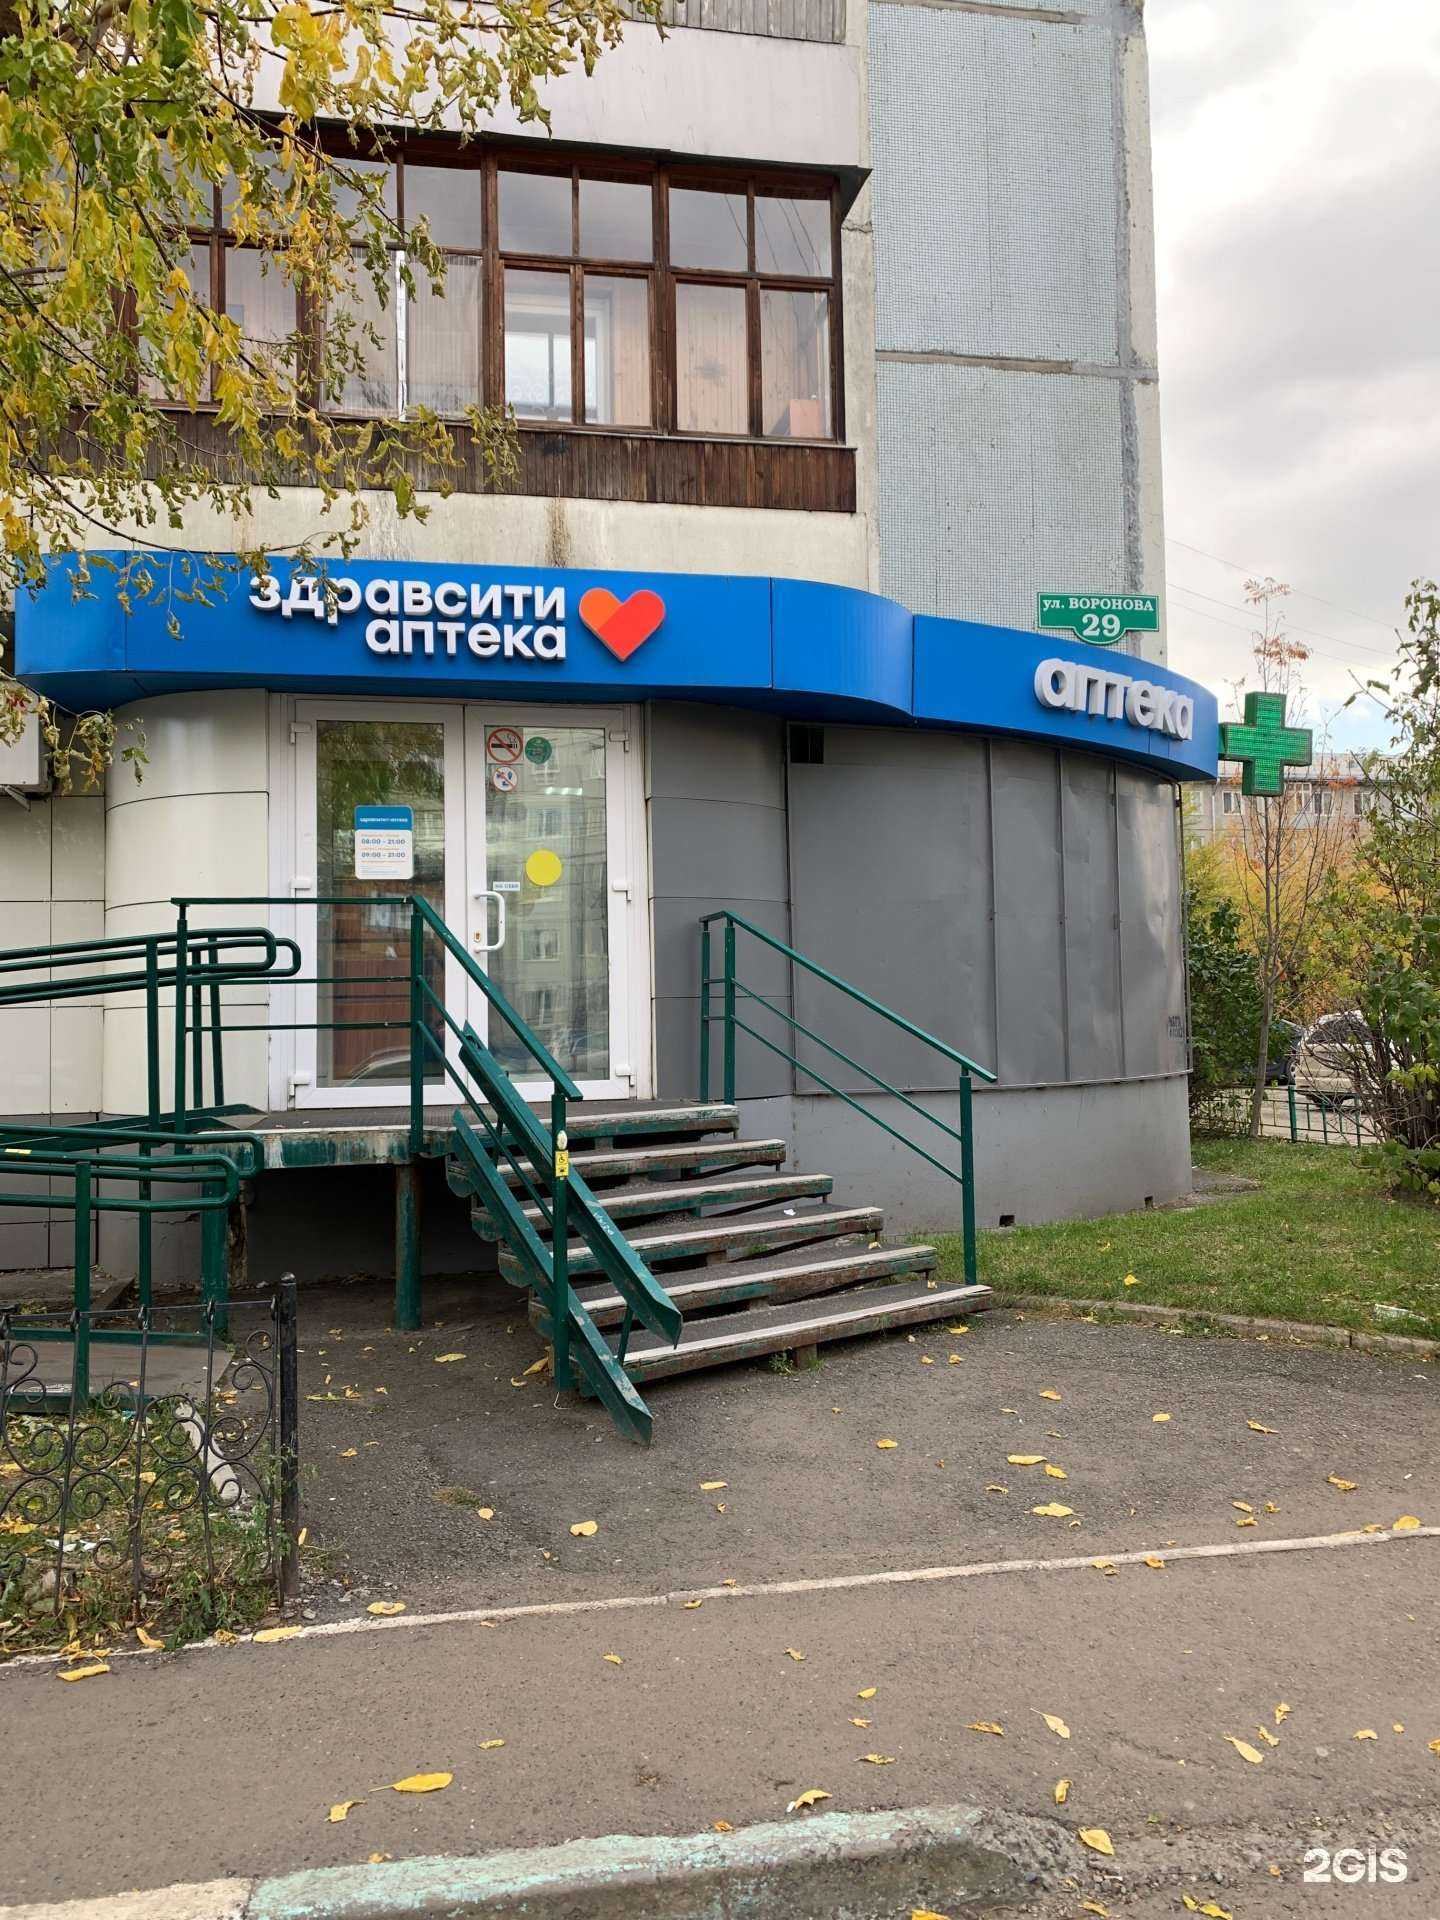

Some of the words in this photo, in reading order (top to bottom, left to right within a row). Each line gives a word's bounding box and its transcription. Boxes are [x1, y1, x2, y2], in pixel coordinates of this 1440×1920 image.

[249, 575, 566, 625] здравсити
[1042, 599, 1065, 612] ул.
[1069, 598, 1154, 611] ВОРОНОВА
[365, 618, 567, 660] аптека
[1082, 613, 1121, 637] 29
[1034, 658, 1194, 741] аптека
